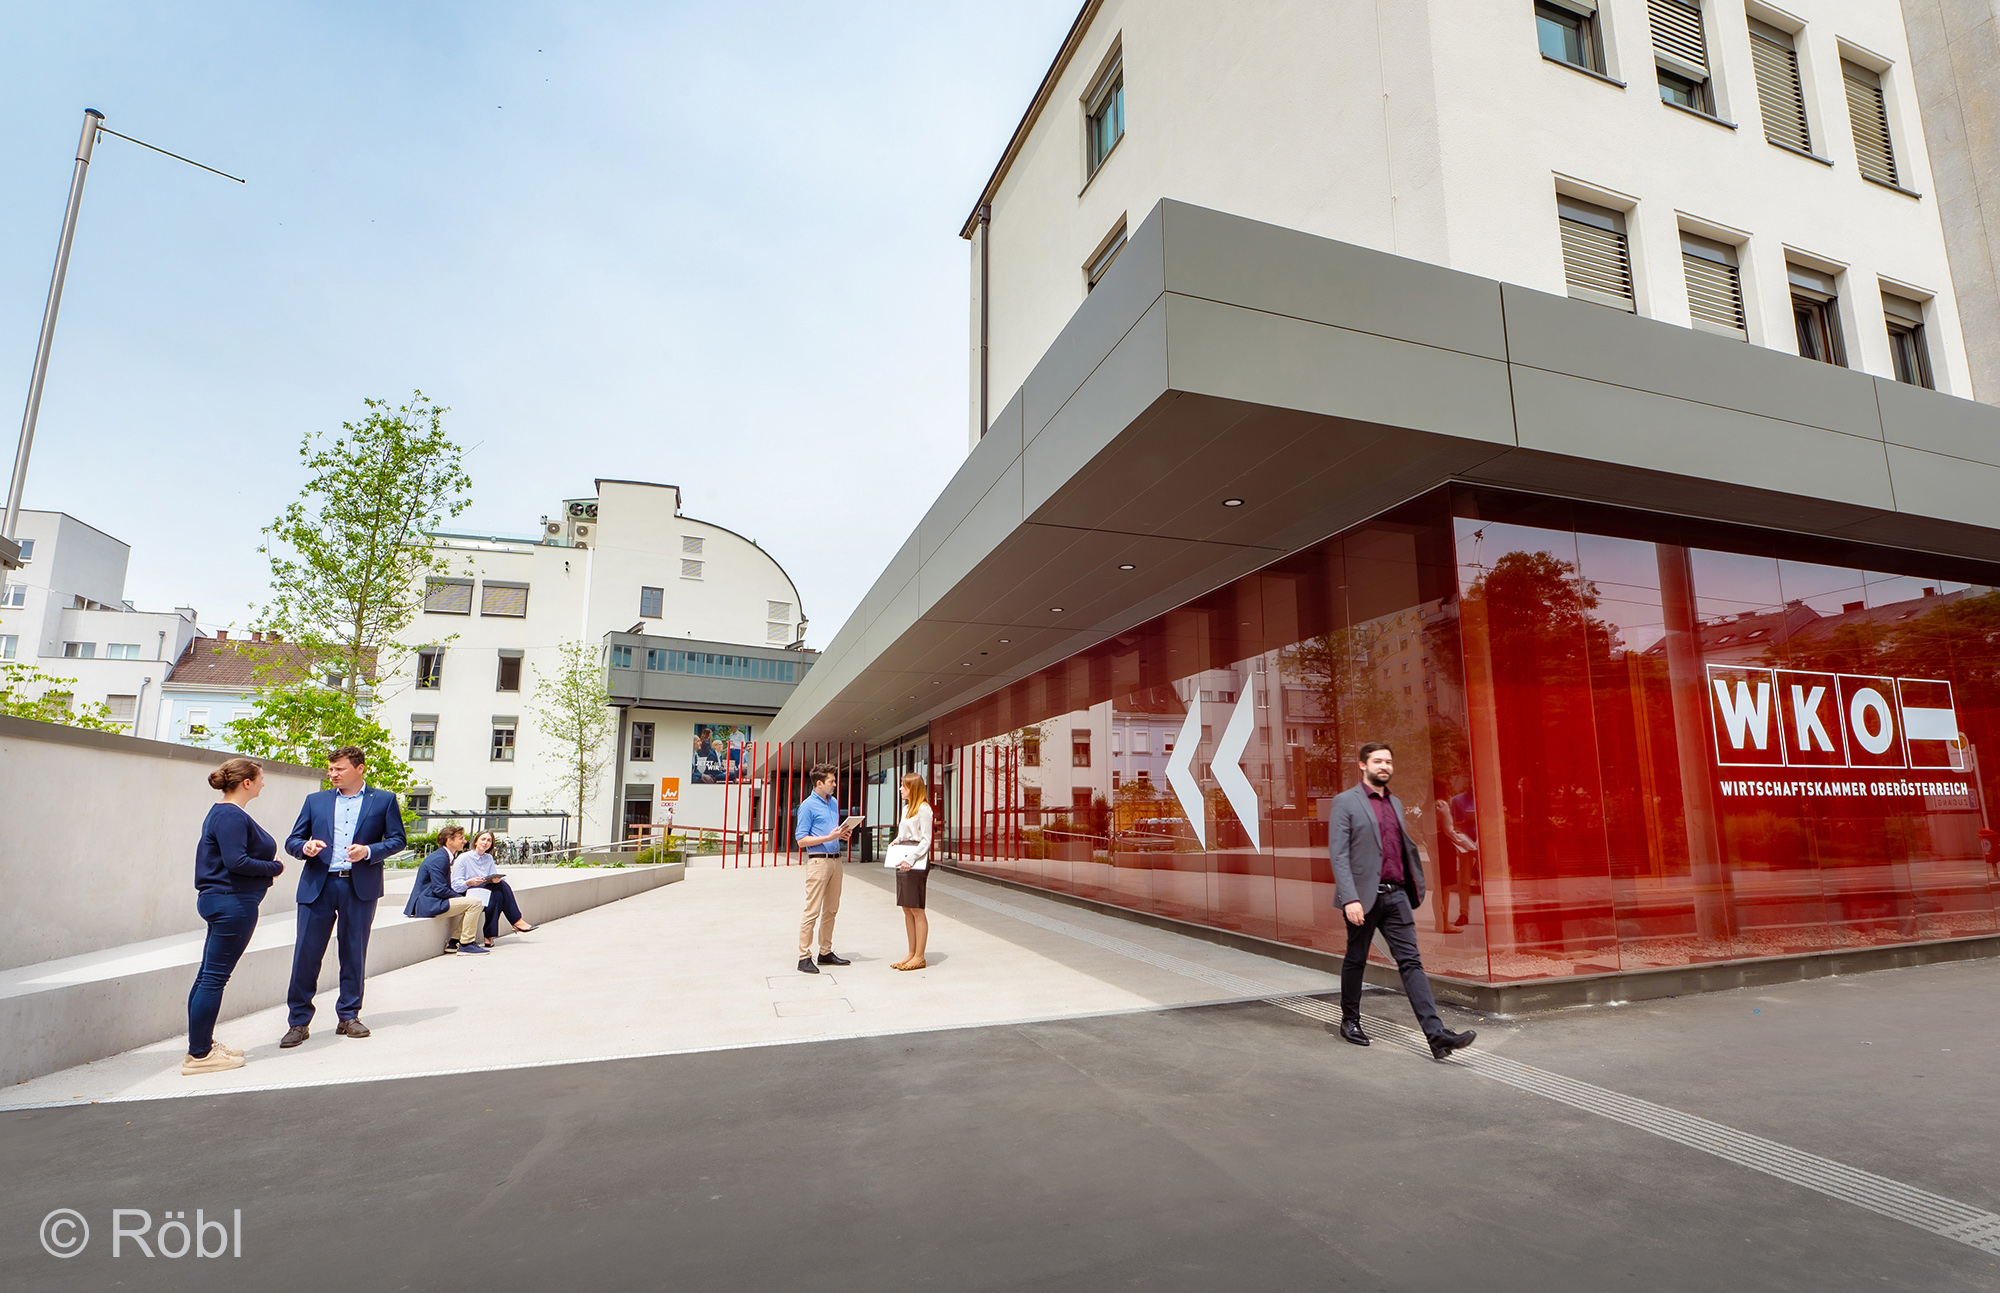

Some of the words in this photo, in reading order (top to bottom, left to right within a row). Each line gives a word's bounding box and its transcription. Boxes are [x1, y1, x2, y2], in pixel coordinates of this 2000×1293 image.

[1713, 679, 1893, 754] WKO
[1720, 780, 1867, 797] WIRTSCHAFTSKAMMER
[1870, 778, 1968, 796] OBERÖSTERREICH
